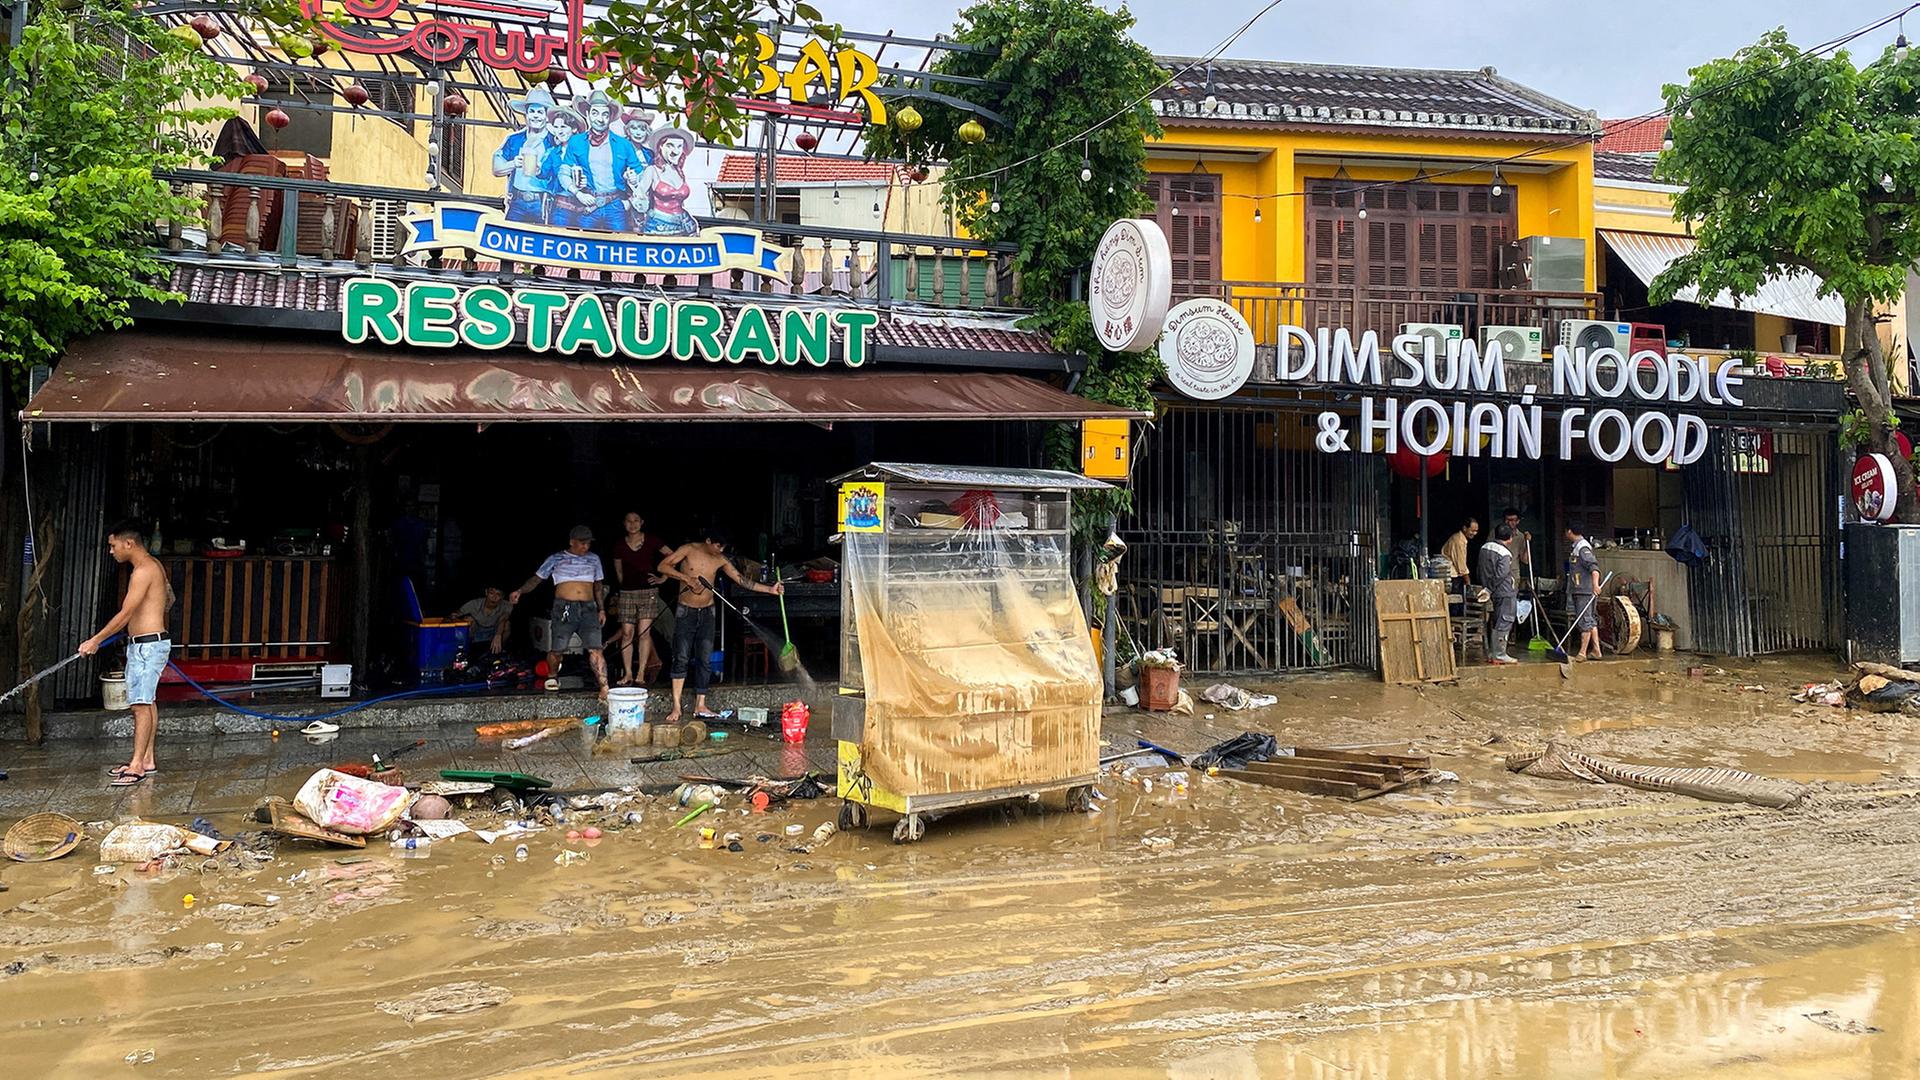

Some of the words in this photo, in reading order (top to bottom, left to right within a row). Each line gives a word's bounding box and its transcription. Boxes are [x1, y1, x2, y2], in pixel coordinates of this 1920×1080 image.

[734, 32, 887, 125] BAR
[486, 230, 535, 253] ONE
[541, 236, 589, 259] FOR
[594, 243, 640, 265] THE
[645, 243, 715, 265] ROAD!
[342, 276, 879, 368] RESTAURANT
[1276, 323, 1383, 386] DIM
[1553, 344, 1744, 408] NOODLE
[1316, 411, 1352, 454] &
[1559, 406, 1710, 466] FOOD
[1854, 475, 1863, 486] ICE
